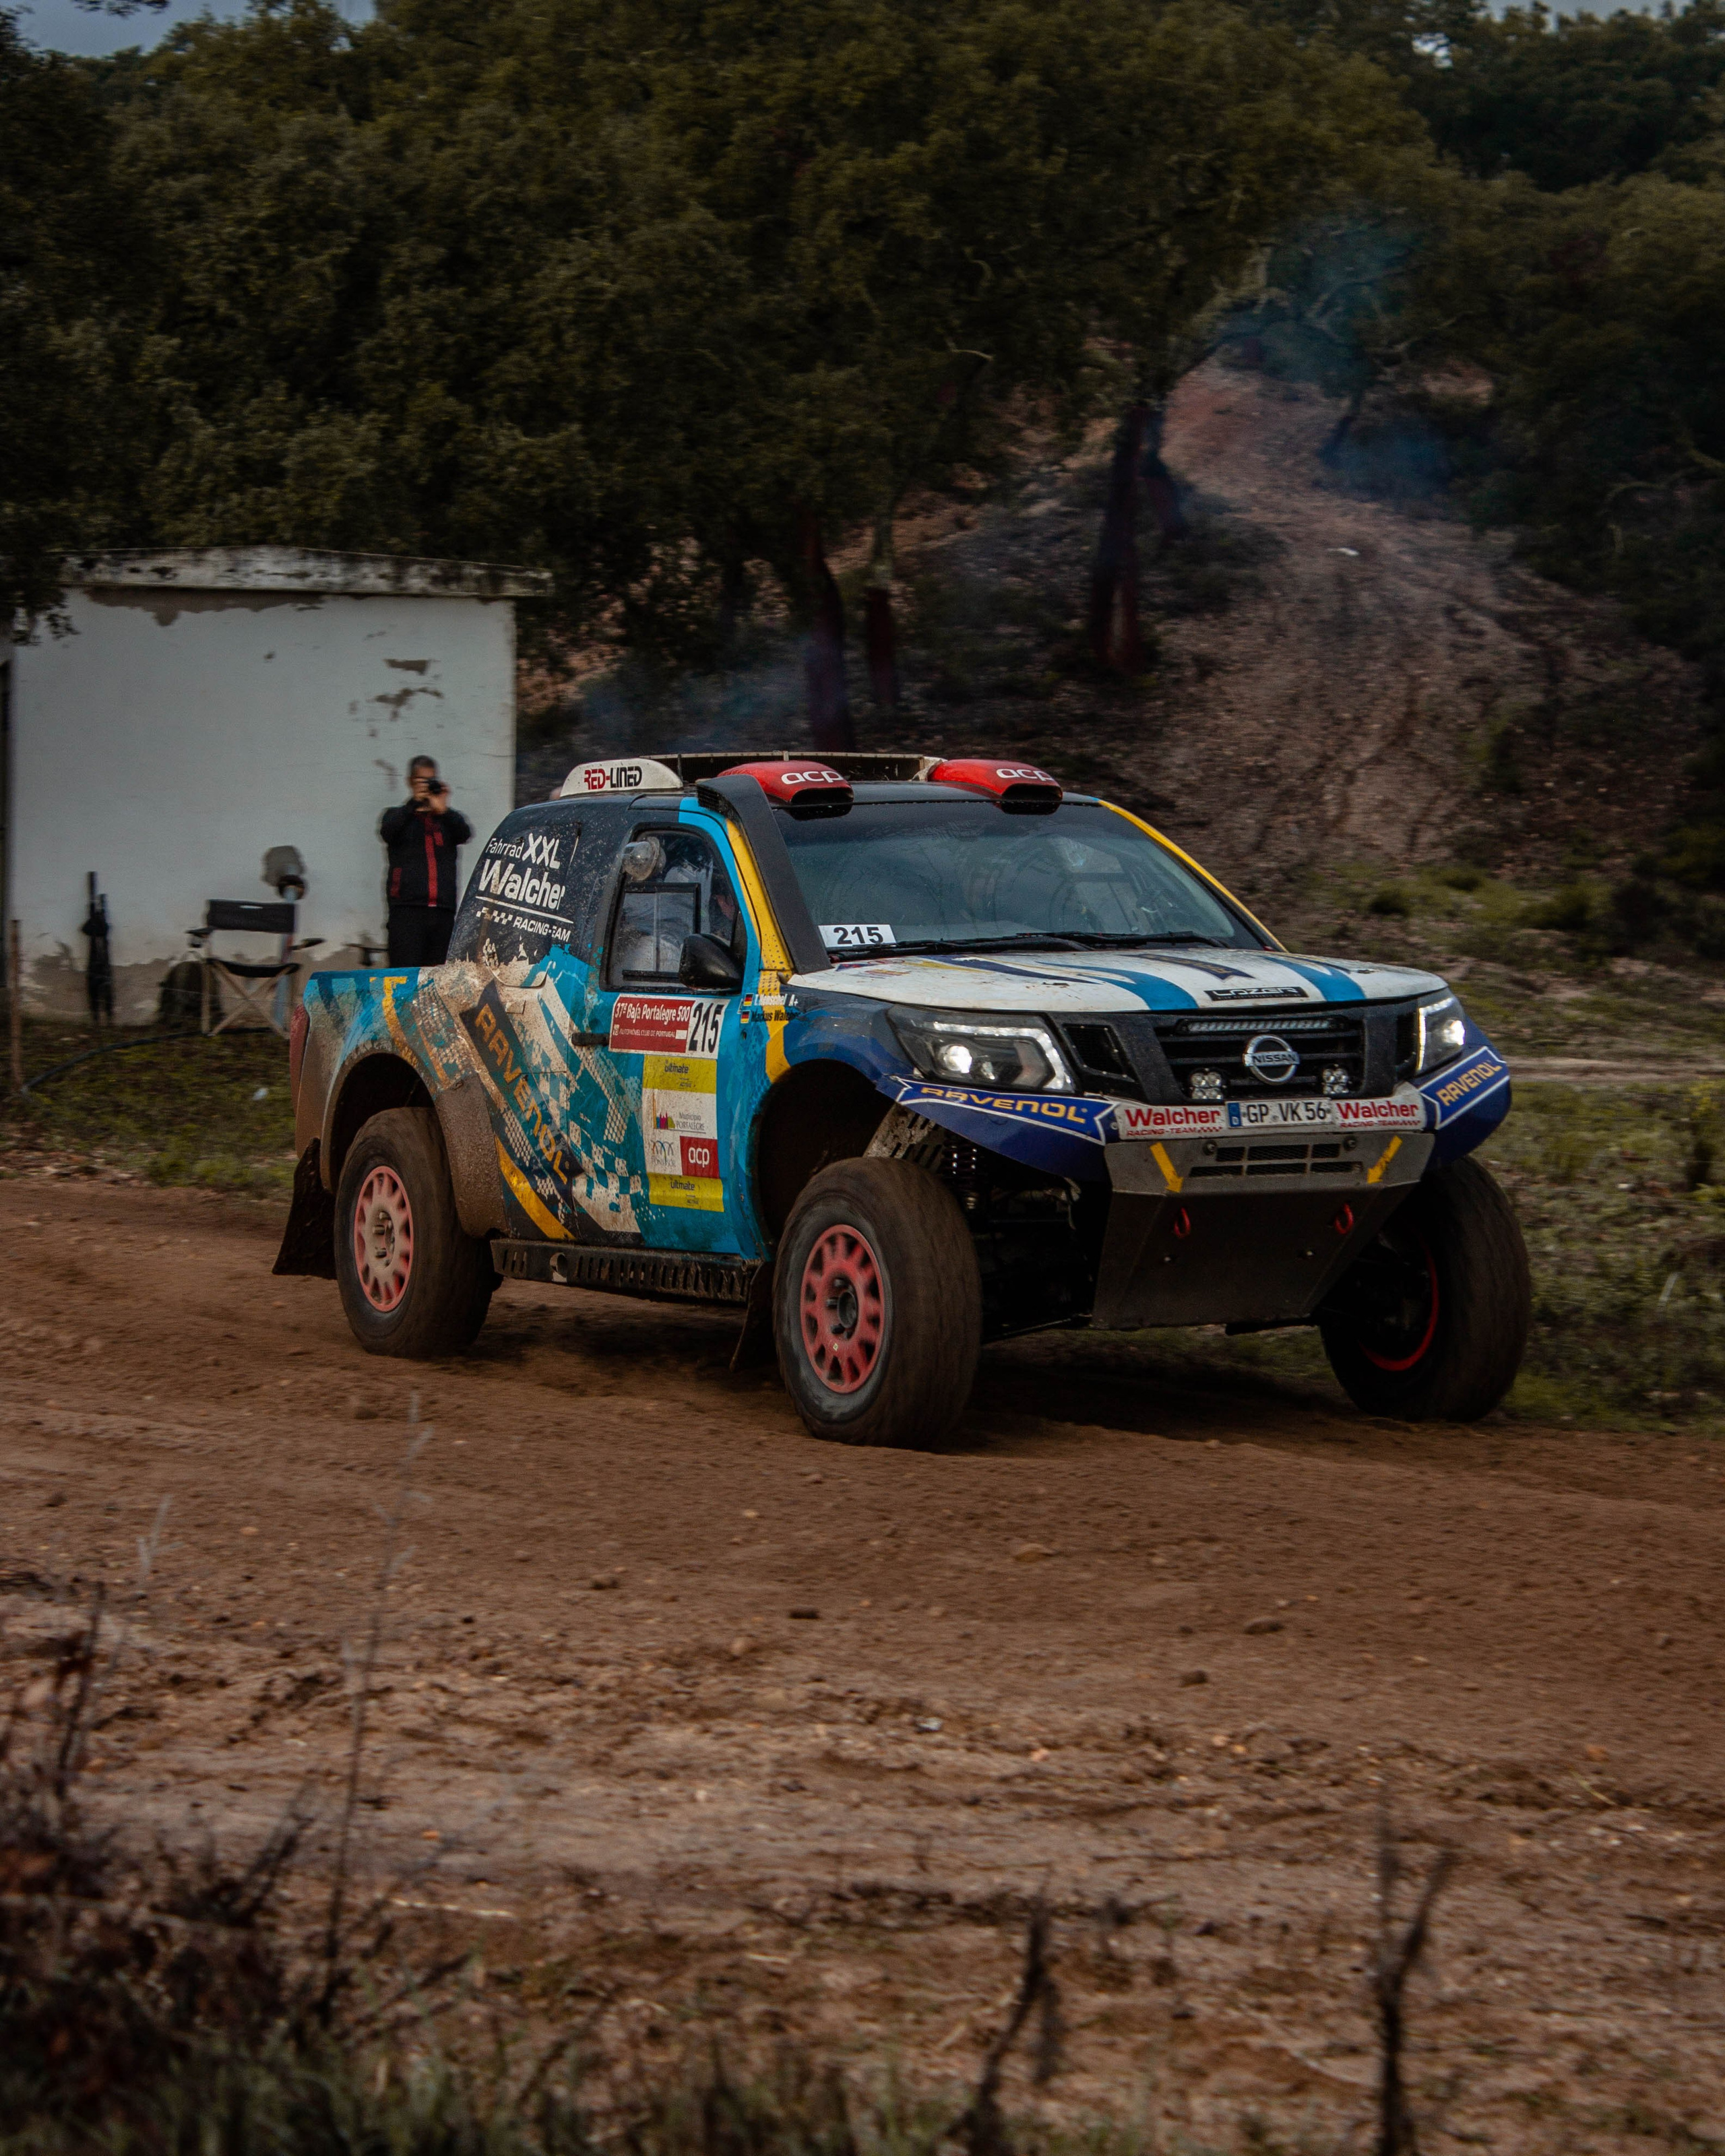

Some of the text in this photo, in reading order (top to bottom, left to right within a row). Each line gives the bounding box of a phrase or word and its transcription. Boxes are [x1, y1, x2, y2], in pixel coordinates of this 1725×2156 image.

[584, 766, 642, 790] RED-LINED
[781, 770, 844, 785] acp
[996, 768, 1054, 782] acp
[485, 833, 561, 869] Fahrrad XXL
[478, 858, 566, 910] Walcher
[833, 926, 883, 945] 215
[1212, 987, 1297, 996] LAZER
[627, 1002, 641, 1023] Baja
[641, 1004, 676, 1025] Portalegre
[677, 1005, 691, 1022] 500
[688, 1002, 725, 1054] 215
[1252, 1052, 1296, 1064] NISSAN
[474, 1003, 568, 1185] RAVENOL
[1436, 1062, 1503, 1106] RAVENOL
[920, 1087, 1086, 1124] RAVENOL
[1247, 1104, 1269, 1124] GP
[1278, 1102, 1303, 1122] VK
[1305, 1101, 1327, 1120] 56
[1336, 1100, 1419, 1119] Walcher
[1125, 1107, 1221, 1127] Walcher
[1126, 1127, 1197, 1137] RACING-TEAM
[688, 1147, 710, 1168] acp
